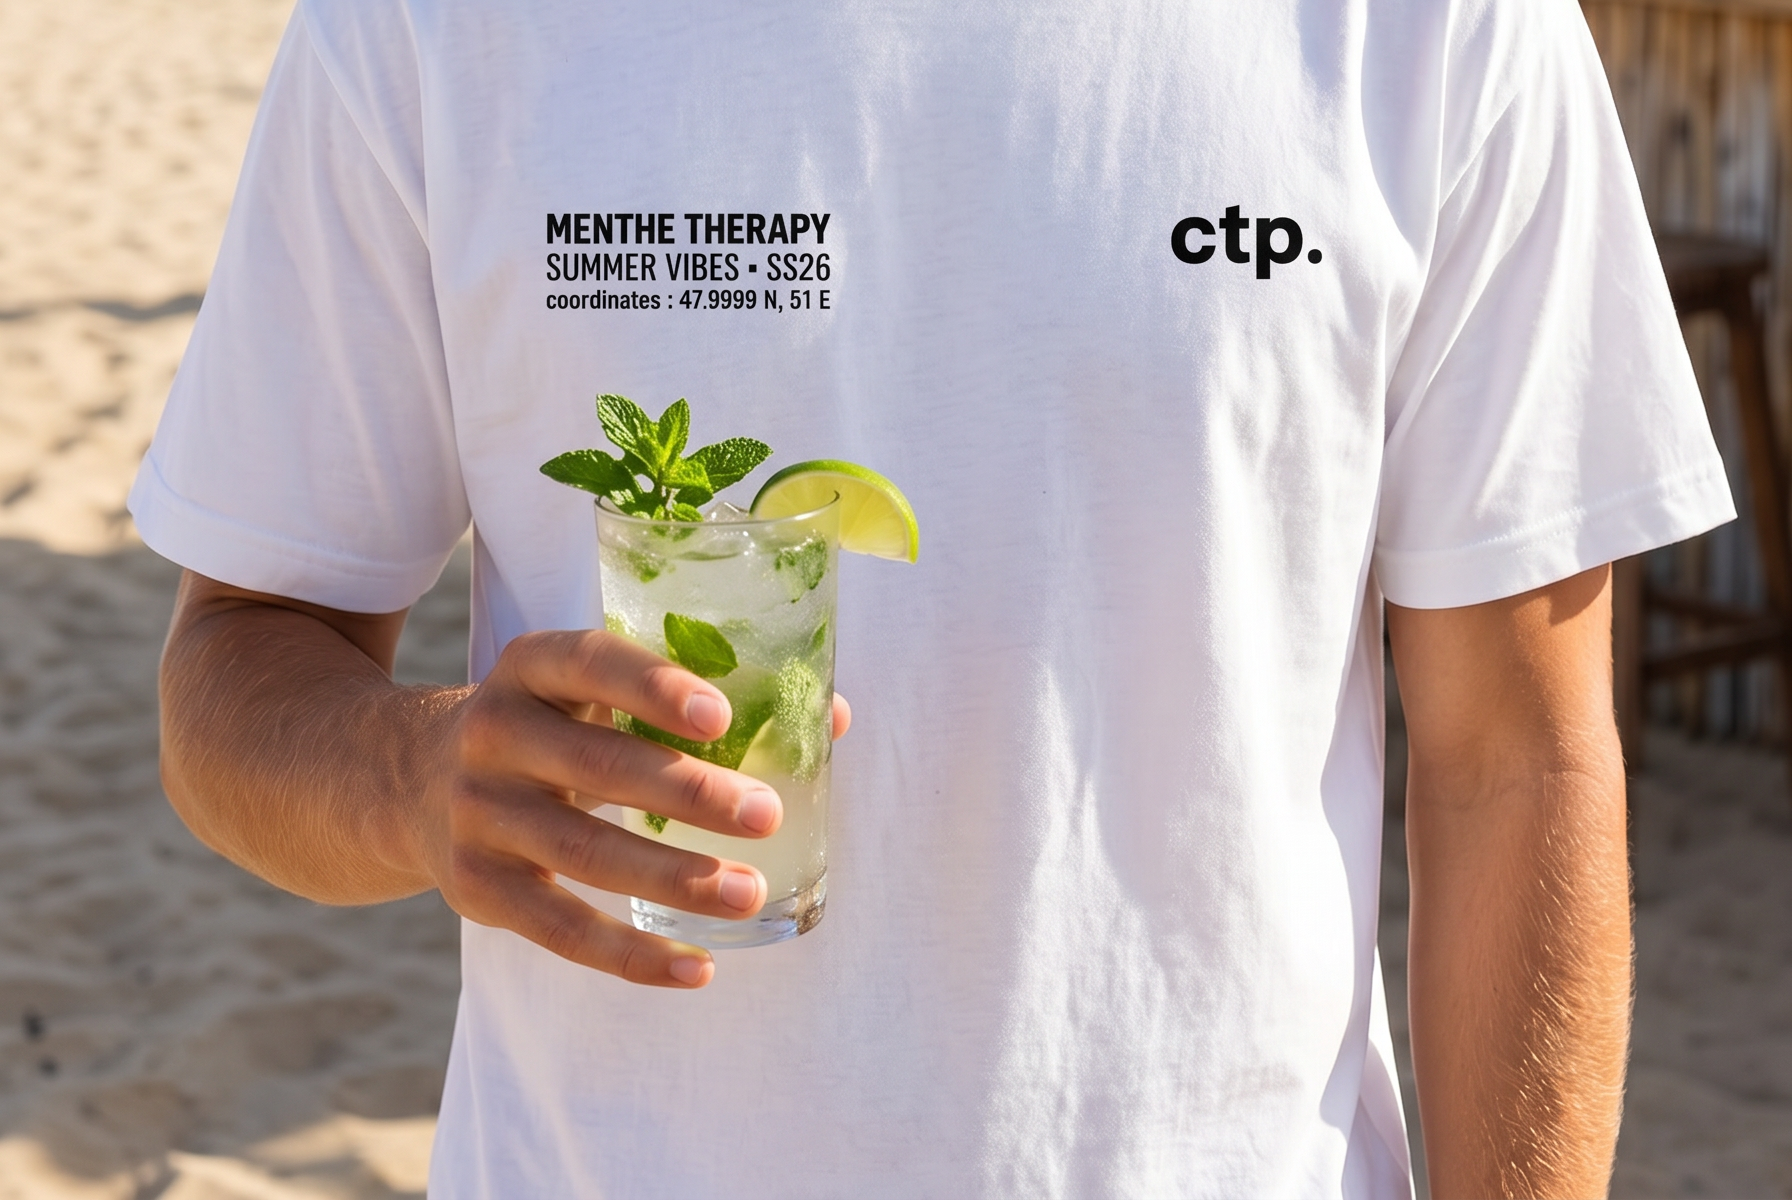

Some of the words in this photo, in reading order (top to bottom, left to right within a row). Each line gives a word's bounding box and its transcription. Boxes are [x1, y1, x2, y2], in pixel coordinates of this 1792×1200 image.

[546, 213, 676, 245] MENTHE
[683, 213, 831, 245] THERAPY
[1170, 204, 1323, 280] ctp.
[546, 252, 657, 282] SUMMER
[665, 252, 740, 282] VIBES
[766, 252, 831, 282] SS26
[546, 289, 661, 310] coordinates
[678, 289, 757, 310] 47.9999
[764, 289, 783, 314] N,
[789, 289, 811, 310] 51
[819, 289, 831, 310] E
